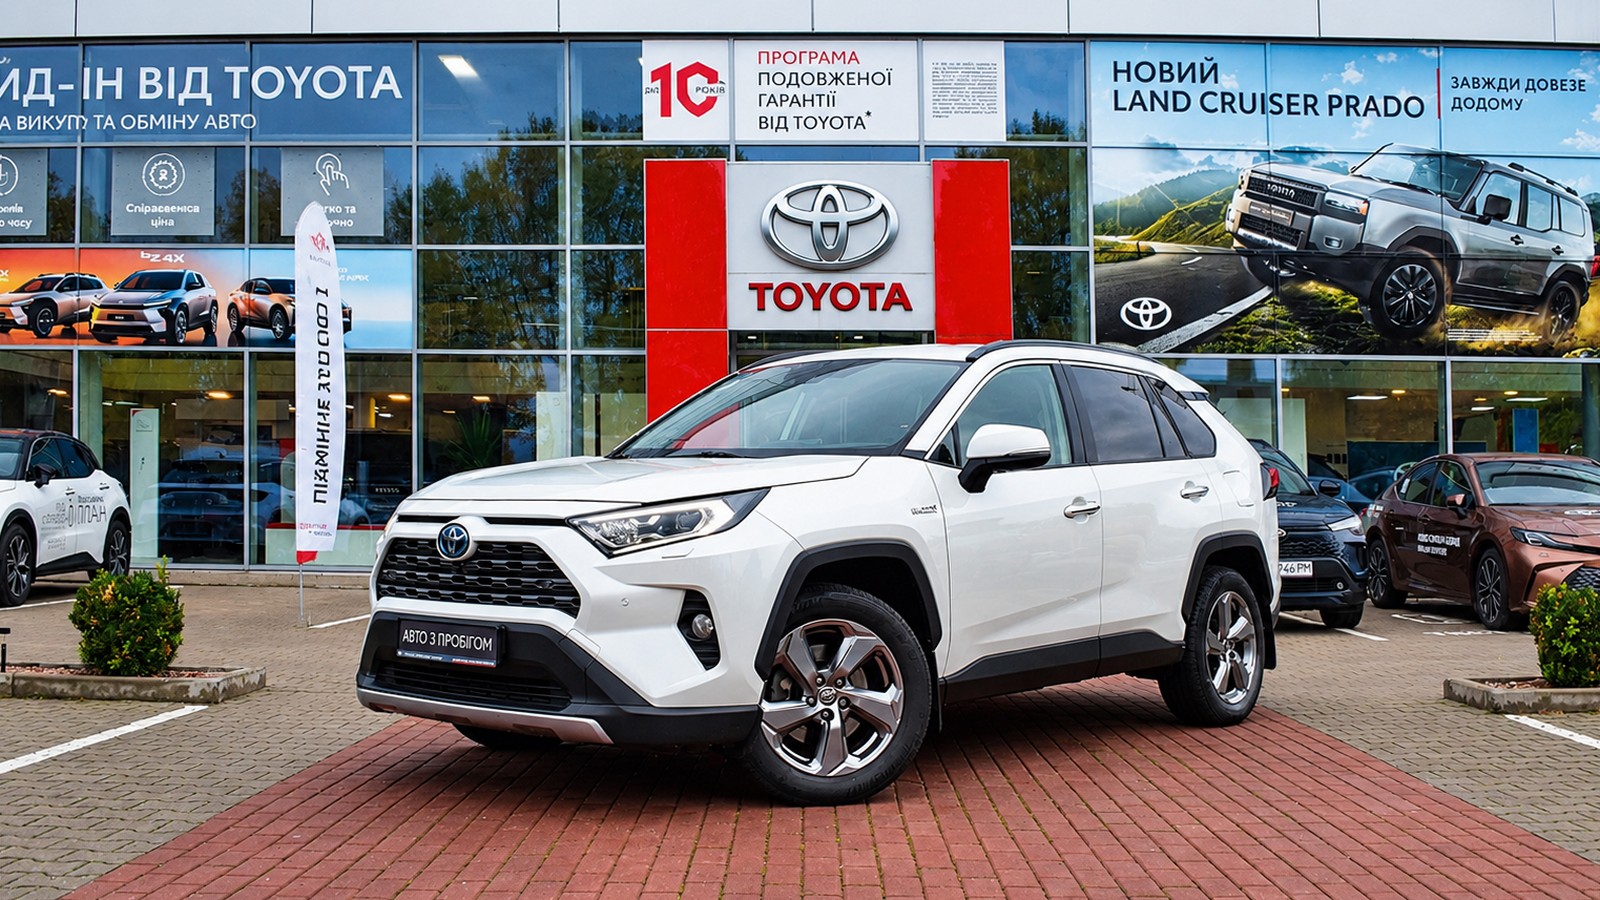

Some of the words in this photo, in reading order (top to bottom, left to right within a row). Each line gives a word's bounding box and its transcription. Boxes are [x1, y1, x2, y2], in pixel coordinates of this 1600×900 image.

[757, 50, 861, 65] ПРОГРАМА
[758, 67, 893, 89] ПОДОВЖЕНОЇ
[1112, 56, 1219, 84] НОВИЙ
[138, 66, 213, 107] ВІД
[224, 65, 403, 100] TOYOTA
[1450, 76, 1520, 93] ЗАВЖДИ
[1524, 78, 1587, 94] ДОВЕЗЕ
[758, 90, 837, 108] ГАРАНТІЇ
[1113, 89, 1192, 113] LAND
[1199, 90, 1320, 117] CRUISER
[1327, 93, 1425, 119] PRADO
[1450, 96, 1524, 112] ДОДОМУ
[93, 114, 116, 130] ТА
[120, 114, 200, 131] ОБМІНУ
[204, 113, 257, 130] АВТО
[758, 115, 789, 133] ВІД
[748, 281, 914, 312] TOYOTA
[402, 629, 428, 645] АВТО
[438, 632, 493, 652] ПРОБІГОМ
